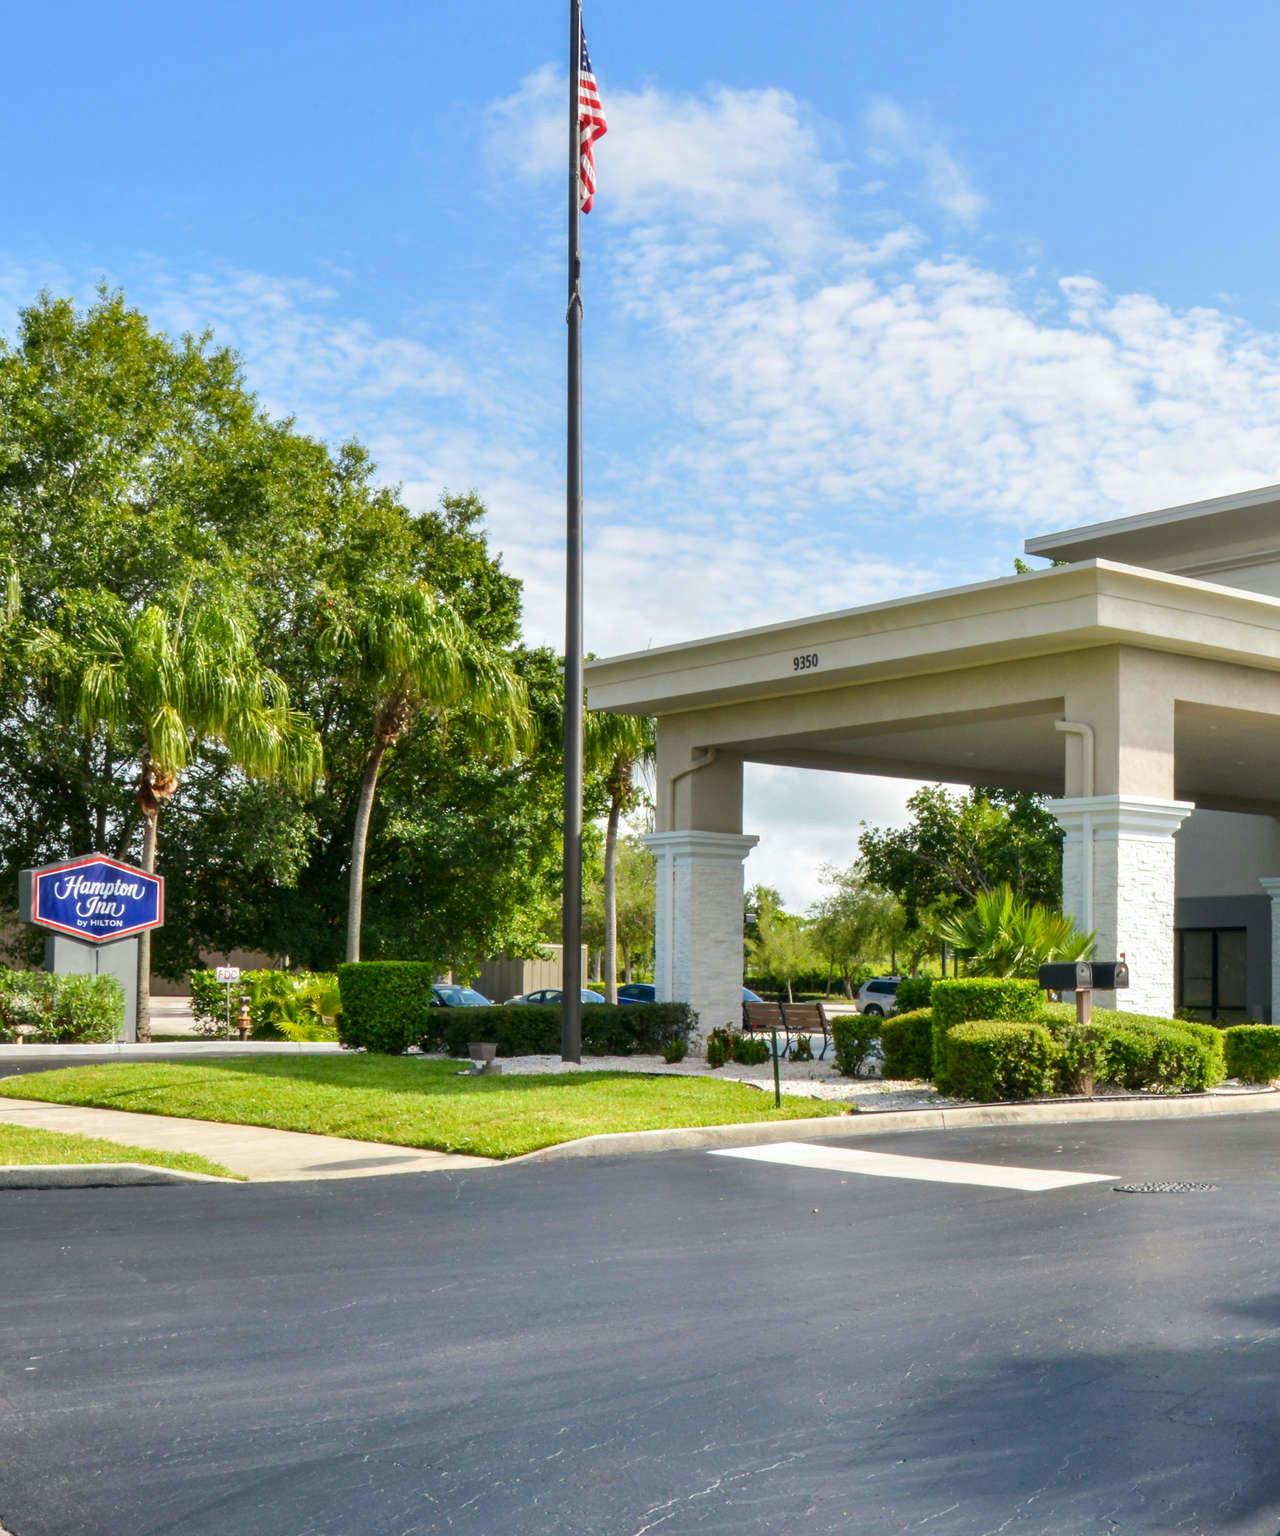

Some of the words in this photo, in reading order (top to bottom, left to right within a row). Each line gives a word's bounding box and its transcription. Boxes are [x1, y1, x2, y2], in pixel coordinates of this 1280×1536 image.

[793, 653, 818, 671] 9350
[54, 874, 145, 900] Hampton
[75, 896, 125, 917] Inn
[76, 919, 88, 928] by
[90, 919, 123, 927] HILTON
